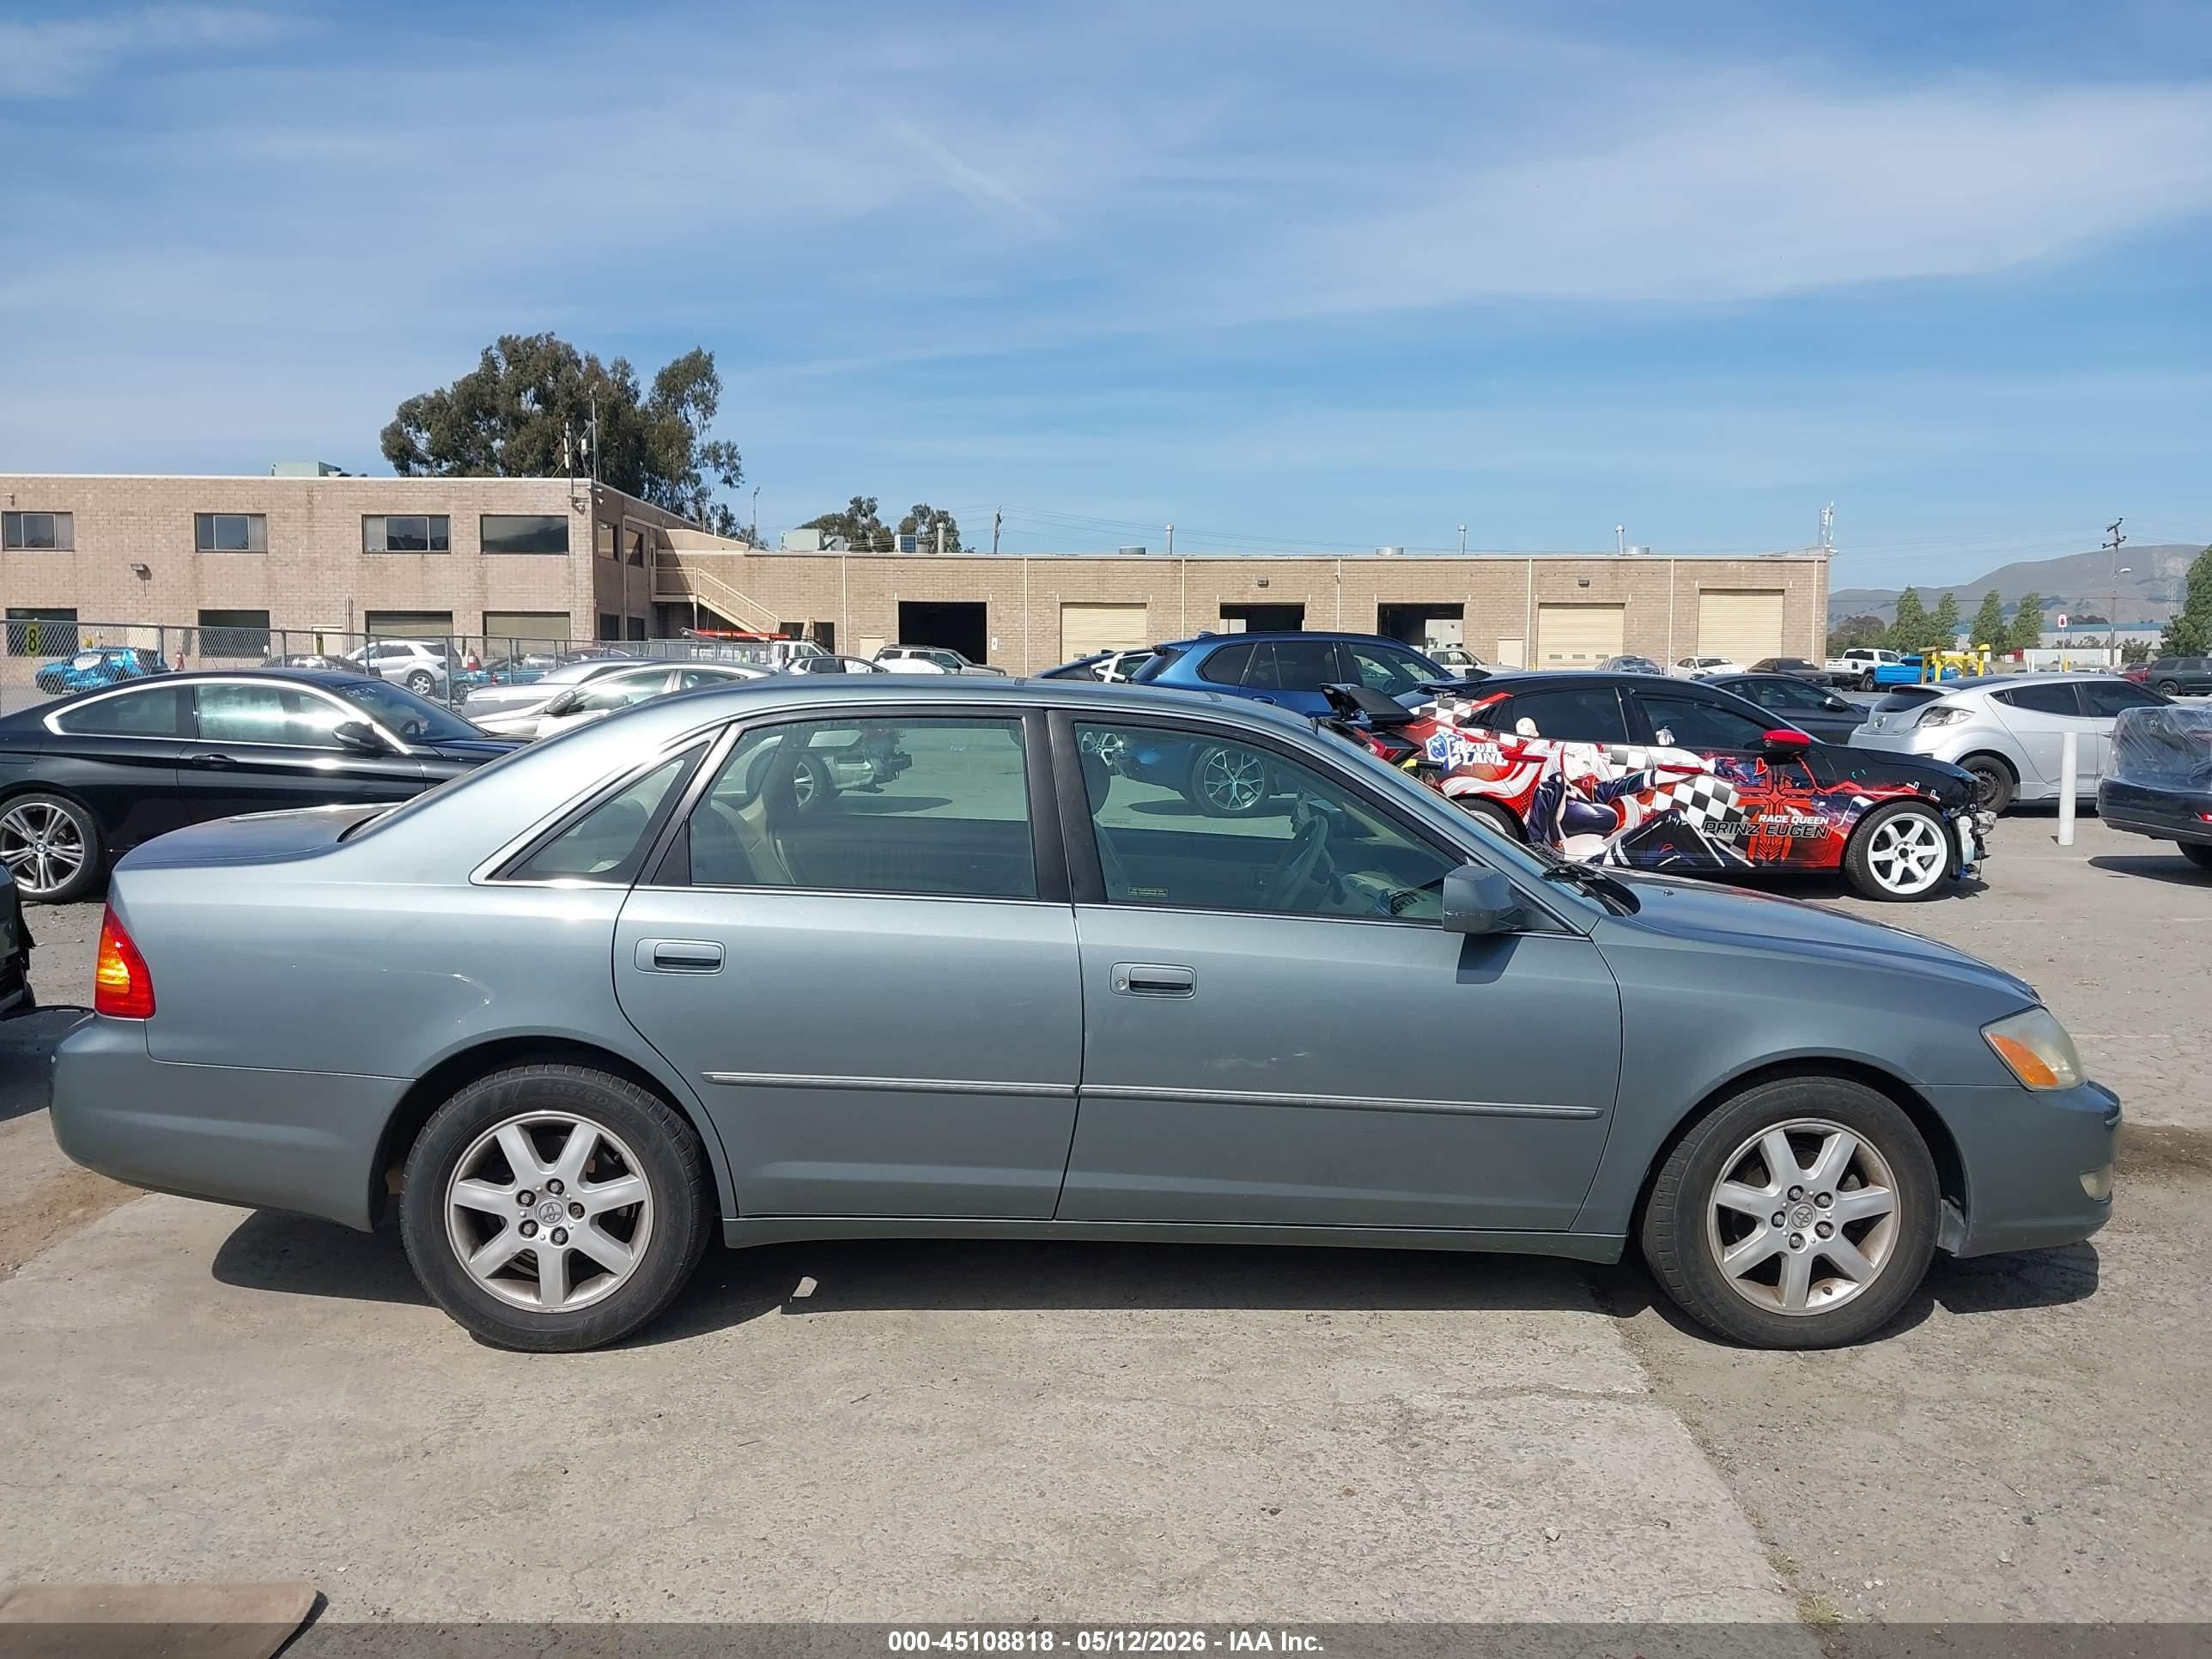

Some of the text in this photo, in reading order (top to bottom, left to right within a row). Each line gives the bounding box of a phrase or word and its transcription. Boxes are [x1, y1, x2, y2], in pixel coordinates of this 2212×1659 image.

[29, 629, 36, 652] 8
[1451, 739, 1498, 752] AZUR
[1462, 751, 1510, 766] LANE
[1758, 814, 1829, 825] RACE QUEEN
[1703, 820, 1828, 839] PRINZ EUGEN
